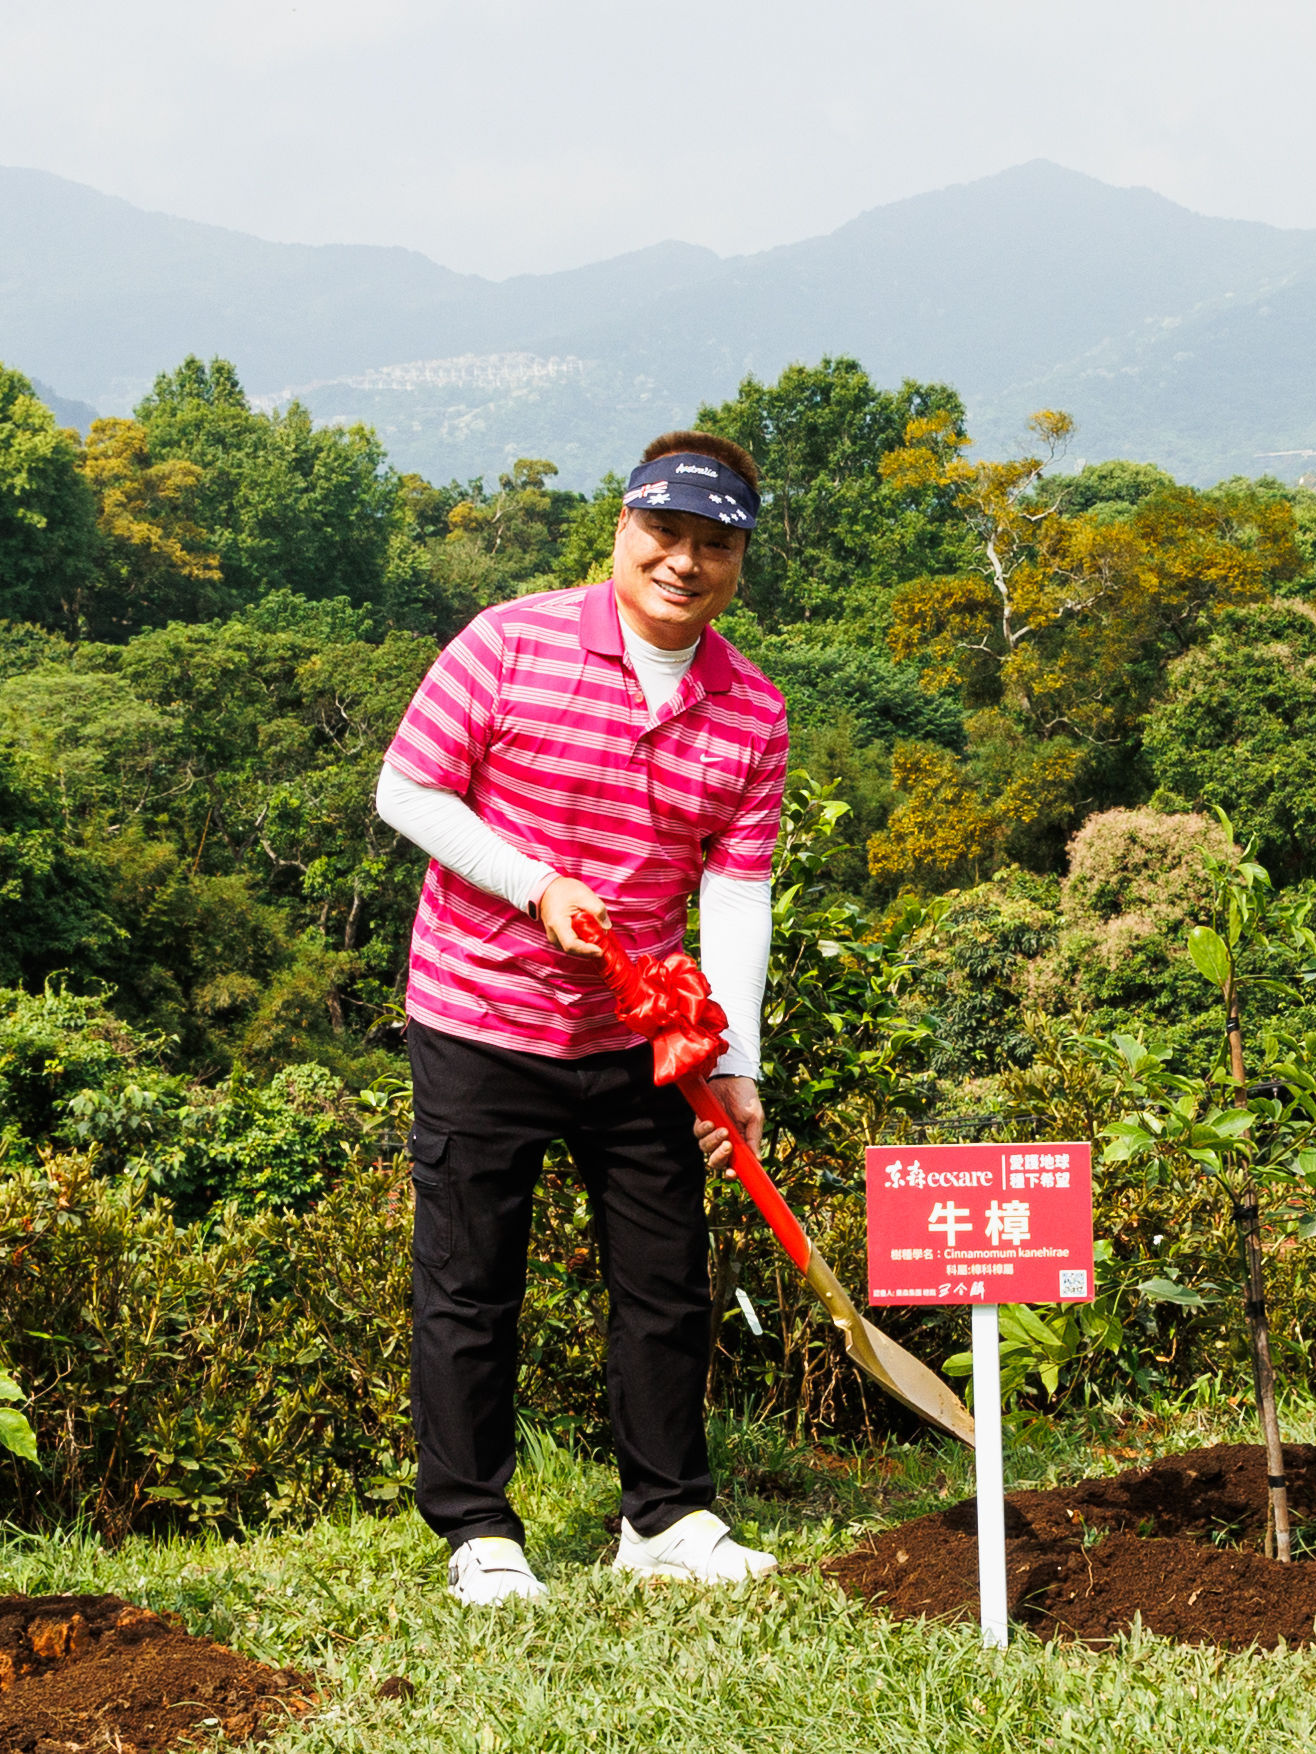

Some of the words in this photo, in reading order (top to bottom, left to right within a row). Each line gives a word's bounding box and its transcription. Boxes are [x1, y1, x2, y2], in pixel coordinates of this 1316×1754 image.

[675, 463, 718, 478] Australia
[1009, 1153, 1070, 1171] 愛護地球
[1009, 1171, 1070, 1189] 種下希望
[927, 1199, 1031, 1247] 牛樟
[943, 1248, 1017, 1260] Cinnamomum
[1018, 1246, 1070, 1258] kanehirae
